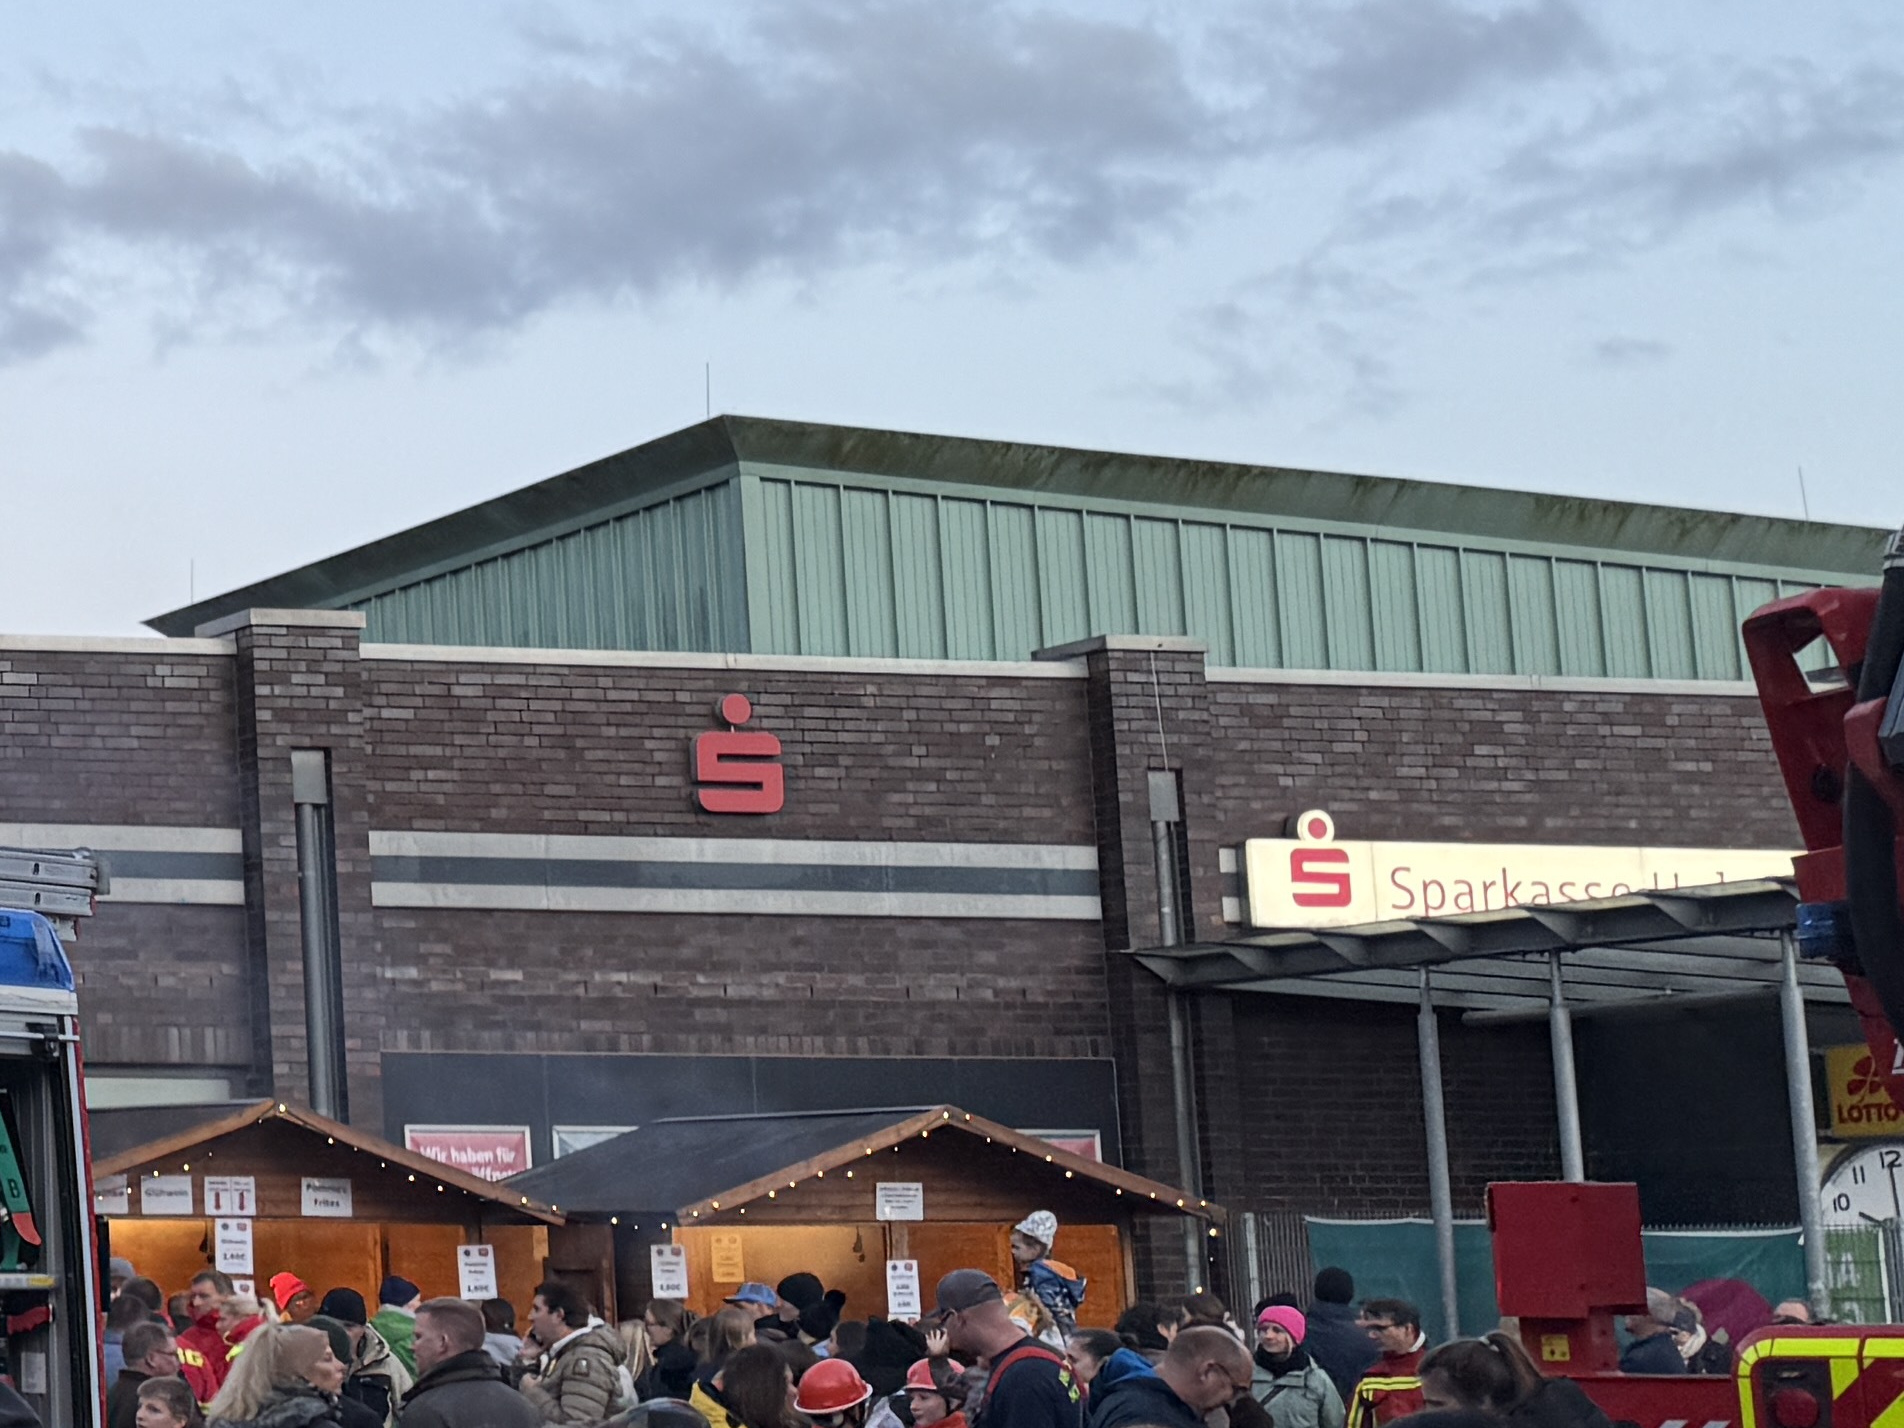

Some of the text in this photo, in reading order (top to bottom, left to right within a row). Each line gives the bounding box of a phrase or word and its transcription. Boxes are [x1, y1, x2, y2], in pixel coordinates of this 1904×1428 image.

[1837, 1103, 1899, 1124] LOTTO
[420, 1145, 516, 1164] Wir haben für
[1879, 1150, 1903, 1169] 12
[1853, 1165, 1866, 1185] 11
[7, 1178, 21, 1199] B
[1833, 1193, 1851, 1213] 10
